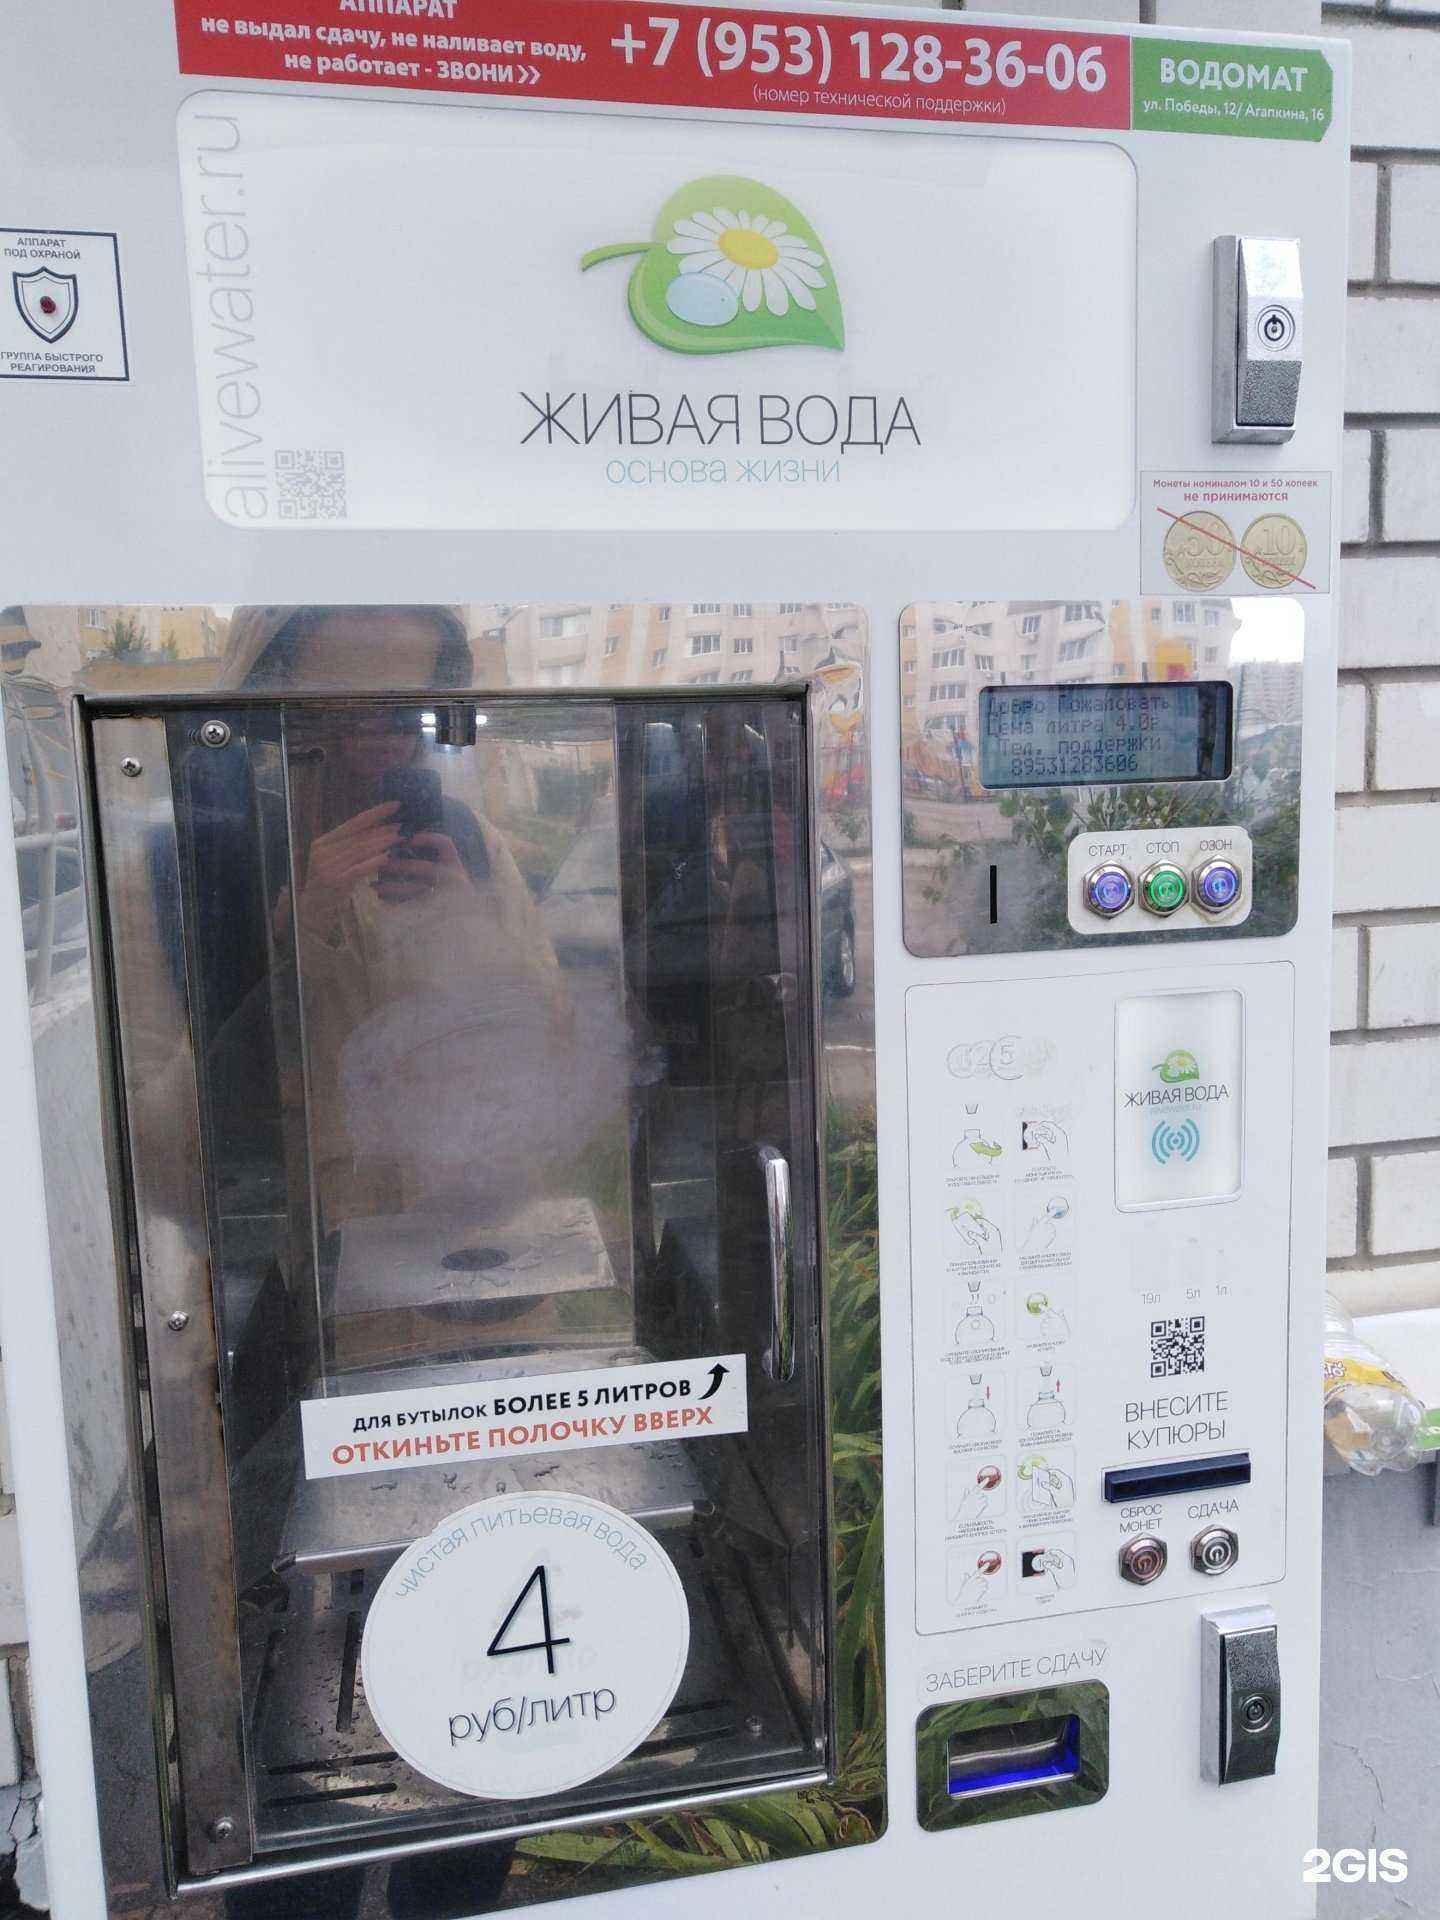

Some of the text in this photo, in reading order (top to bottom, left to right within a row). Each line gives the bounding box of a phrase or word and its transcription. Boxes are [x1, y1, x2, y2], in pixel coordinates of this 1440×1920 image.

[202, 17, 587, 63] не выдал сдачу, не наливает воду,
[610, 16, 1108, 92] +7 (953) 128-36-06
[284, 51, 311, 69] не
[317, 54, 420, 78] работает
[437, 63, 514, 84] ЗВОНИ
[1160, 58, 1308, 92] ВОДОМАТ
[753, 84, 1006, 116] (номер технической поддержки)
[1144, 99, 1161, 114] ул.
[1165, 98, 1219, 116] Победы,
[1247, 104, 1309, 123] Агапкина,
[1312, 108, 1324, 120] 16
[4, 248, 81, 260] ПОД ОХРАНОЙ
[17, 237, 66, 248] АППАРАТ
[194, 114, 269, 519] alivewater.ru
[0, 351, 104, 363] ГРУППА БЫСТРОГО
[10, 362, 96, 374] РЕАГИРОВАНИЯ
[519, 391, 922, 455] ЖИВАЯ ВОДА
[606, 458, 841, 484] основа жизни
[1153, 479, 1190, 488] Монеты
[1193, 479, 1247, 488] номиналом
[1250, 479, 1260, 488] 10
[1271, 479, 1283, 488] 50
[1286, 480, 1318, 489] копеек
[1184, 492, 1288, 503] не принимаются
[999, 737, 1161, 756] Тел. поддержки
[1011, 754, 1138, 777] 89531283606
[1088, 843, 1127, 857] СТАРТ
[1146, 841, 1180, 854] СТОП
[1200, 840, 1232, 851] ОЗОН
[1124, 1084, 1229, 1107] ЖИВАЯ ВОДА
[1141, 1293, 1161, 1305] 19л
[1186, 1288, 1201, 1300] 5л
[1215, 1285, 1228, 1297] 1л
[396, 1403, 487, 1427] БУТЫЛОК
[493, 1391, 572, 1416] БОЛЕЕ
[577, 1390, 590, 1407] 5
[594, 1379, 691, 1405] ЛИТРОВ
[1125, 1391, 1229, 1423] ВНЕСИТЕ
[332, 1406, 714, 1465] ОТКИНЬТЕ ПОЛОЧКУ ВВЕРХ
[1127, 1420, 1225, 1450] КУПЮРЫ
[1120, 1504, 1163, 1519] СБРОС
[1187, 1499, 1239, 1519] СДАЧА
[1120, 1518, 1163, 1534] МОНЕТ
[471, 1506, 593, 1538] питьевая
[593, 1521, 648, 1570] вода
[487, 1565, 570, 1674] 4
[926, 1647, 1108, 1692] ЗАБЕРИТЕ СДАЧУ
[448, 1688, 615, 1746] руб/литр
